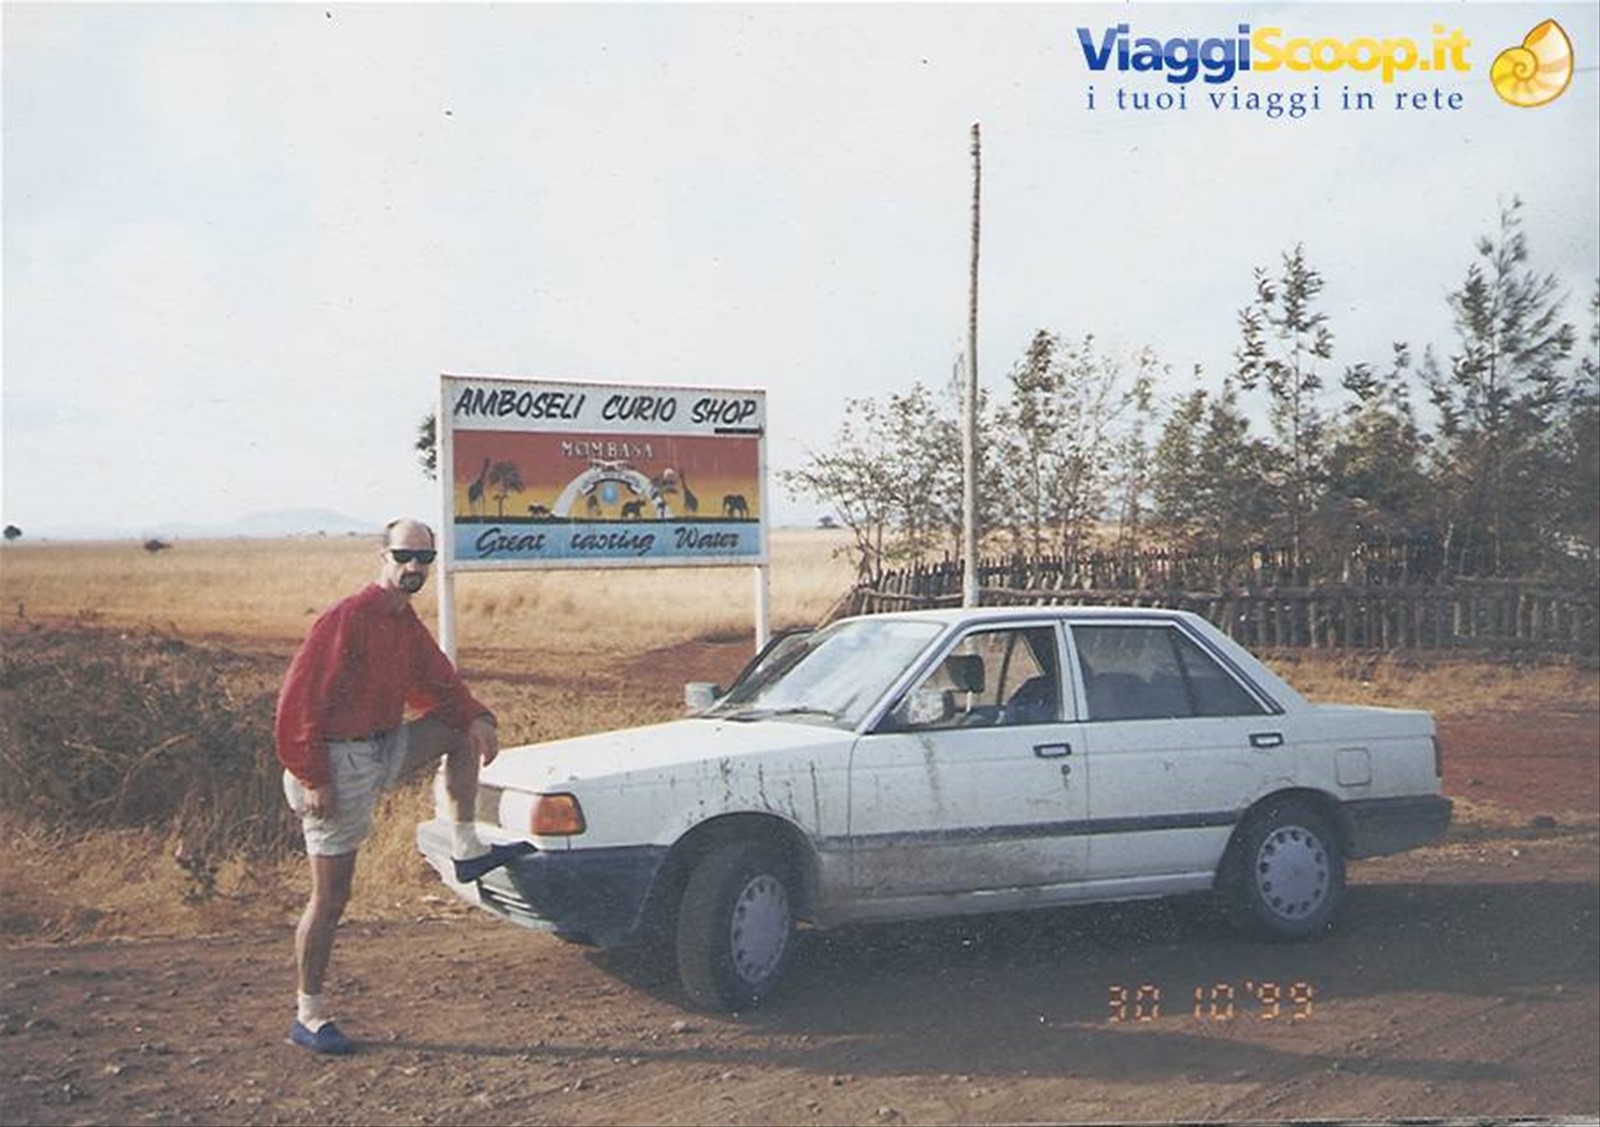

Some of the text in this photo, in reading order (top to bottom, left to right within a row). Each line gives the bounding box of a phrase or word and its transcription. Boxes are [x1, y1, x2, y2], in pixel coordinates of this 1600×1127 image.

[453, 386, 756, 425] AMBOSELI CURIO SHOP
[560, 439, 653, 459] MOMBASA
[476, 526, 740, 558] Great tasting Water
